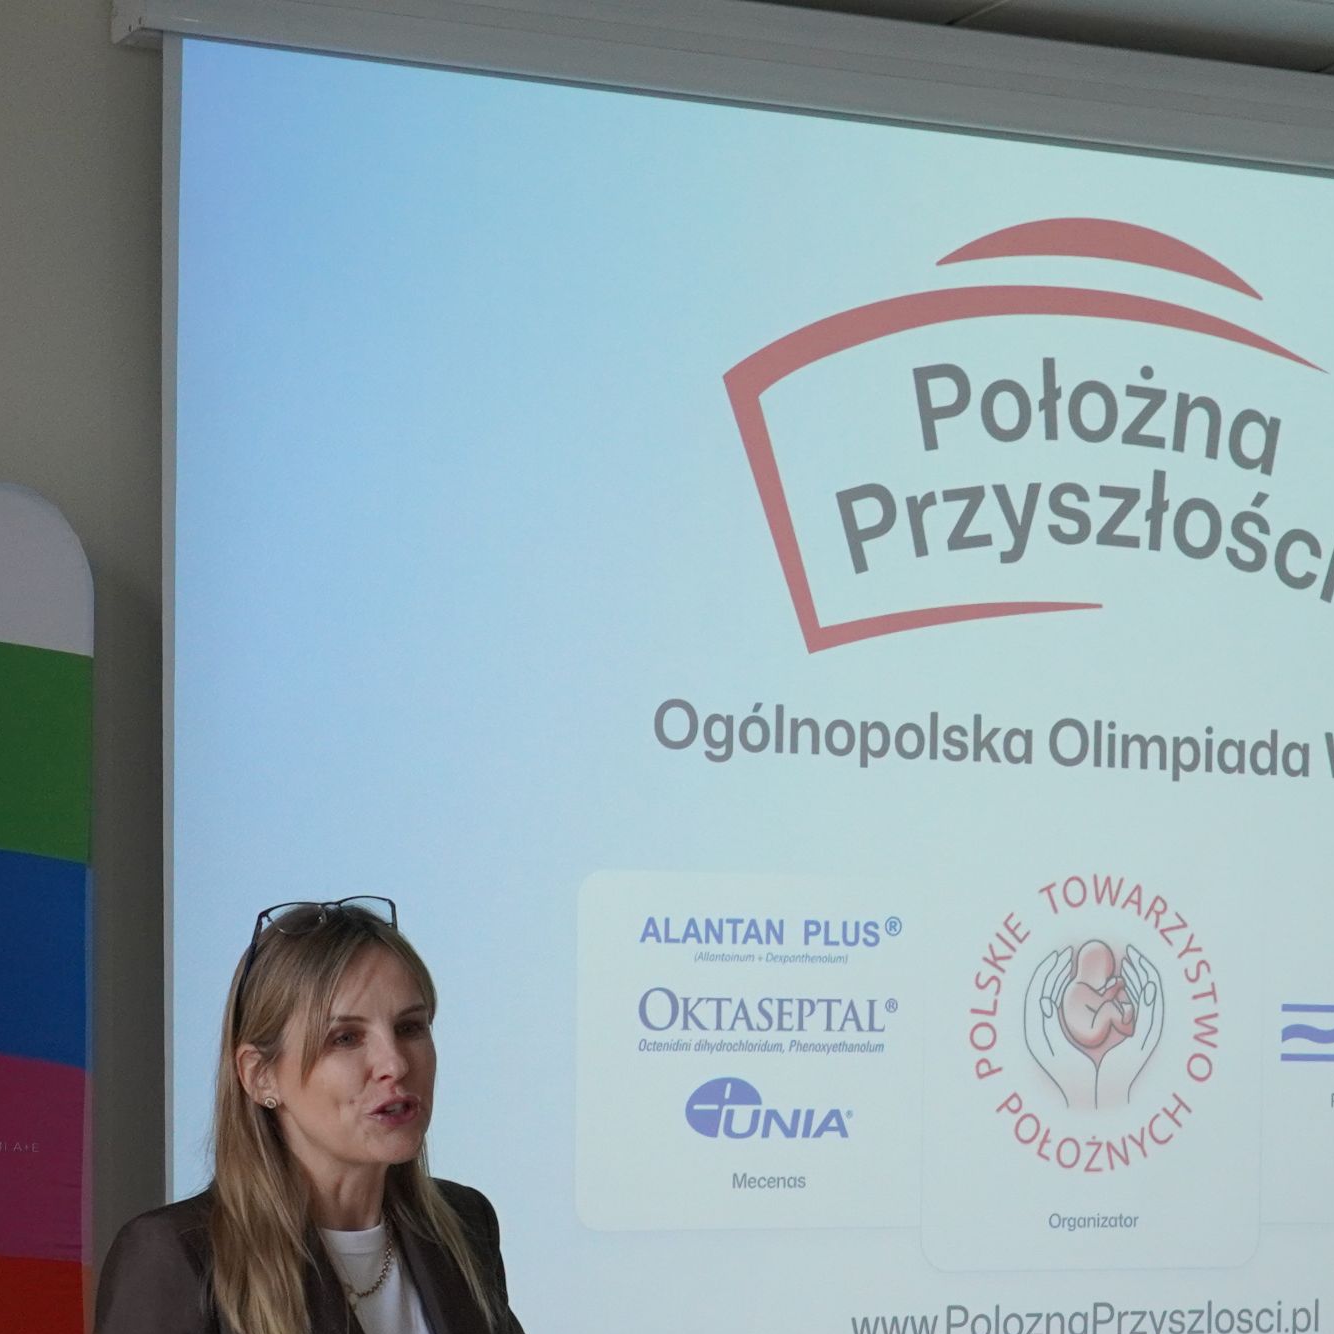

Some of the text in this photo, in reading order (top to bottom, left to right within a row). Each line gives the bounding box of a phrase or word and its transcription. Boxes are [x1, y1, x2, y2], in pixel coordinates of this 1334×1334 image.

[911, 356, 1283, 476] Położna
[653, 698, 1033, 768] Ogólnopolska
[1048, 717, 1310, 783] Olimpiada
[640, 915, 785, 946] ALANTAN
[693, 950, 756, 965] (Allantoinum
[765, 951, 850, 967] Dexpanthenolum)
[968, 911, 1031, 1081] POLSKIE
[1038, 873, 1220, 1083] TOWARZYSTWO
[638, 1037, 886, 1057] Octenidini dihydrochloridum, Phenoxyethanolum
[995, 1091, 1194, 1174] POŁOŻNYCH
[732, 1172, 806, 1190] Mecenas
[1048, 1212, 1139, 1232] Organizator
